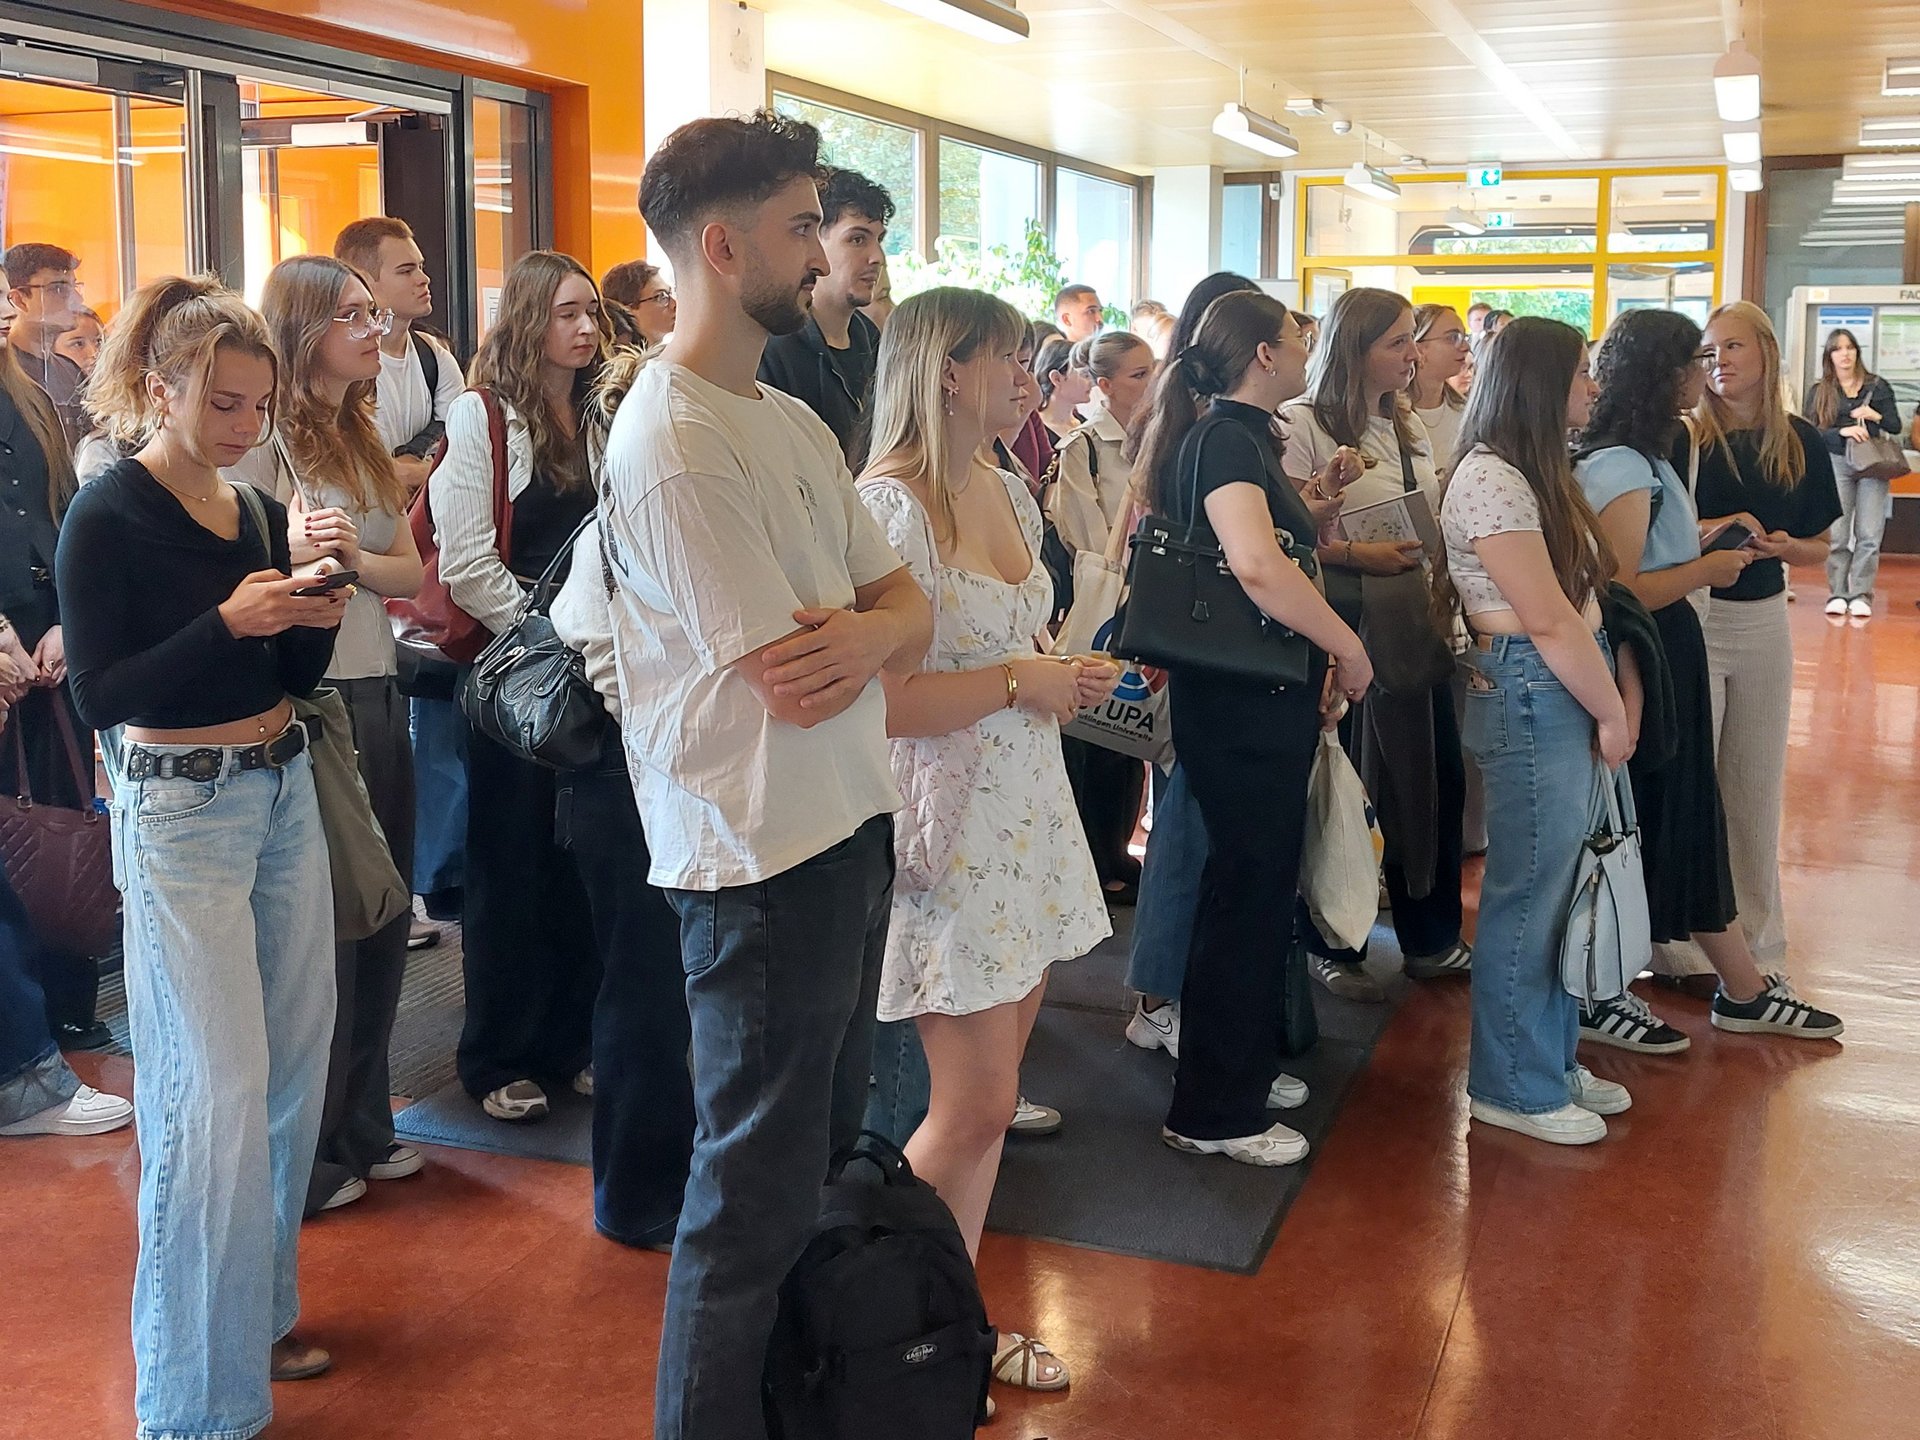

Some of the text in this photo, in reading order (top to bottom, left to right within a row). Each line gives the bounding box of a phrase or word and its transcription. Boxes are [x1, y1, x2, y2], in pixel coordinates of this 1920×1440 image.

[1078, 713, 1153, 742] utlingen University
[1079, 699, 1153, 733] TUPA
